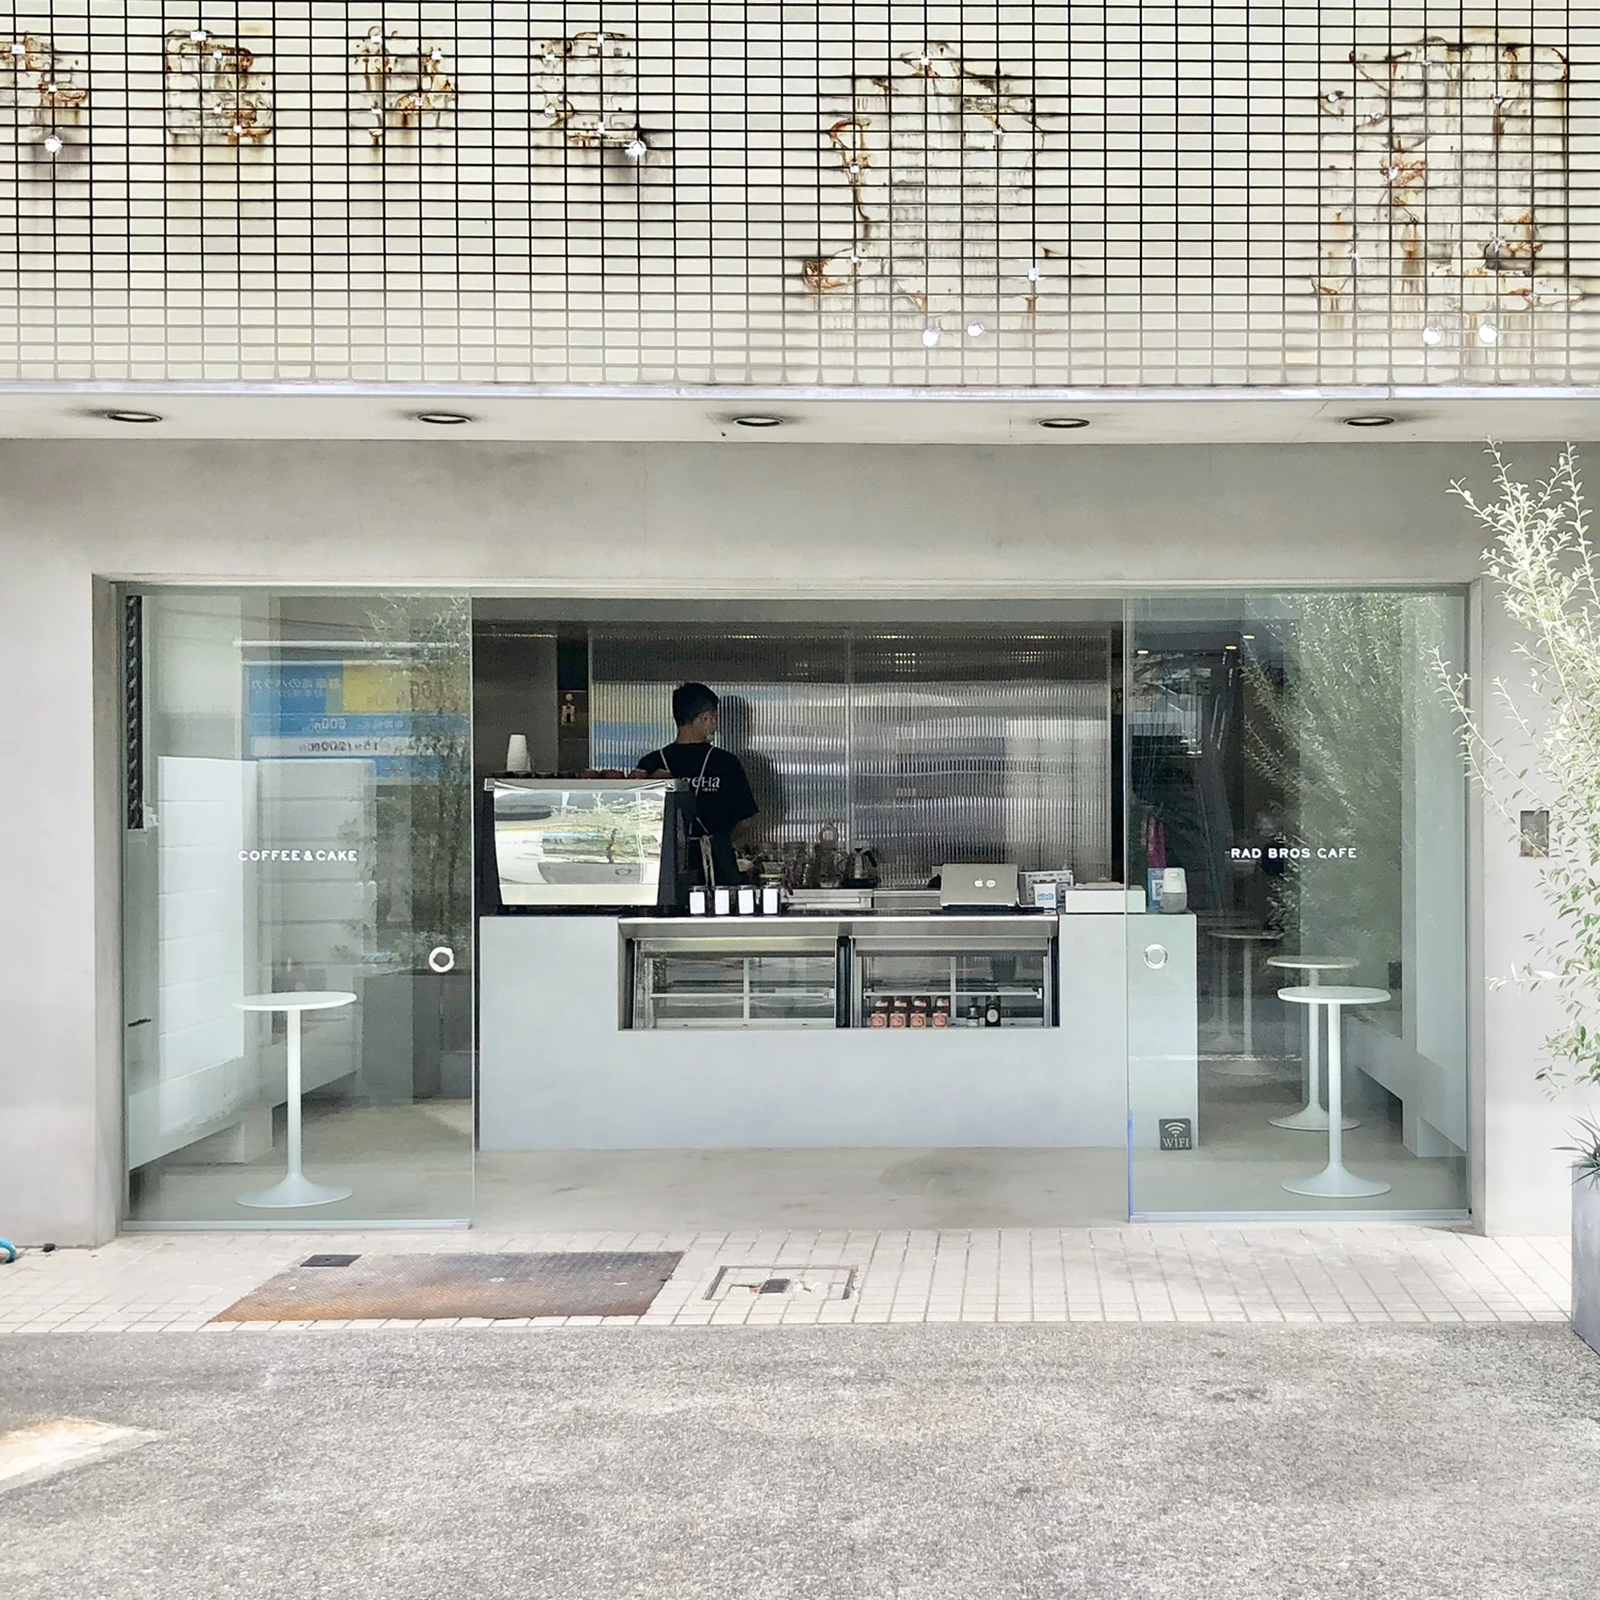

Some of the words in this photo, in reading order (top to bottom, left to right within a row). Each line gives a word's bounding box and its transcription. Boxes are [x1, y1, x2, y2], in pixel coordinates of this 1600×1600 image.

[1230, 847, 1262, 859] RAD
[1268, 847, 1311, 859] BROS
[1316, 847, 1357, 860] CAFE
[1162, 1137, 1190, 1148] WIFI
